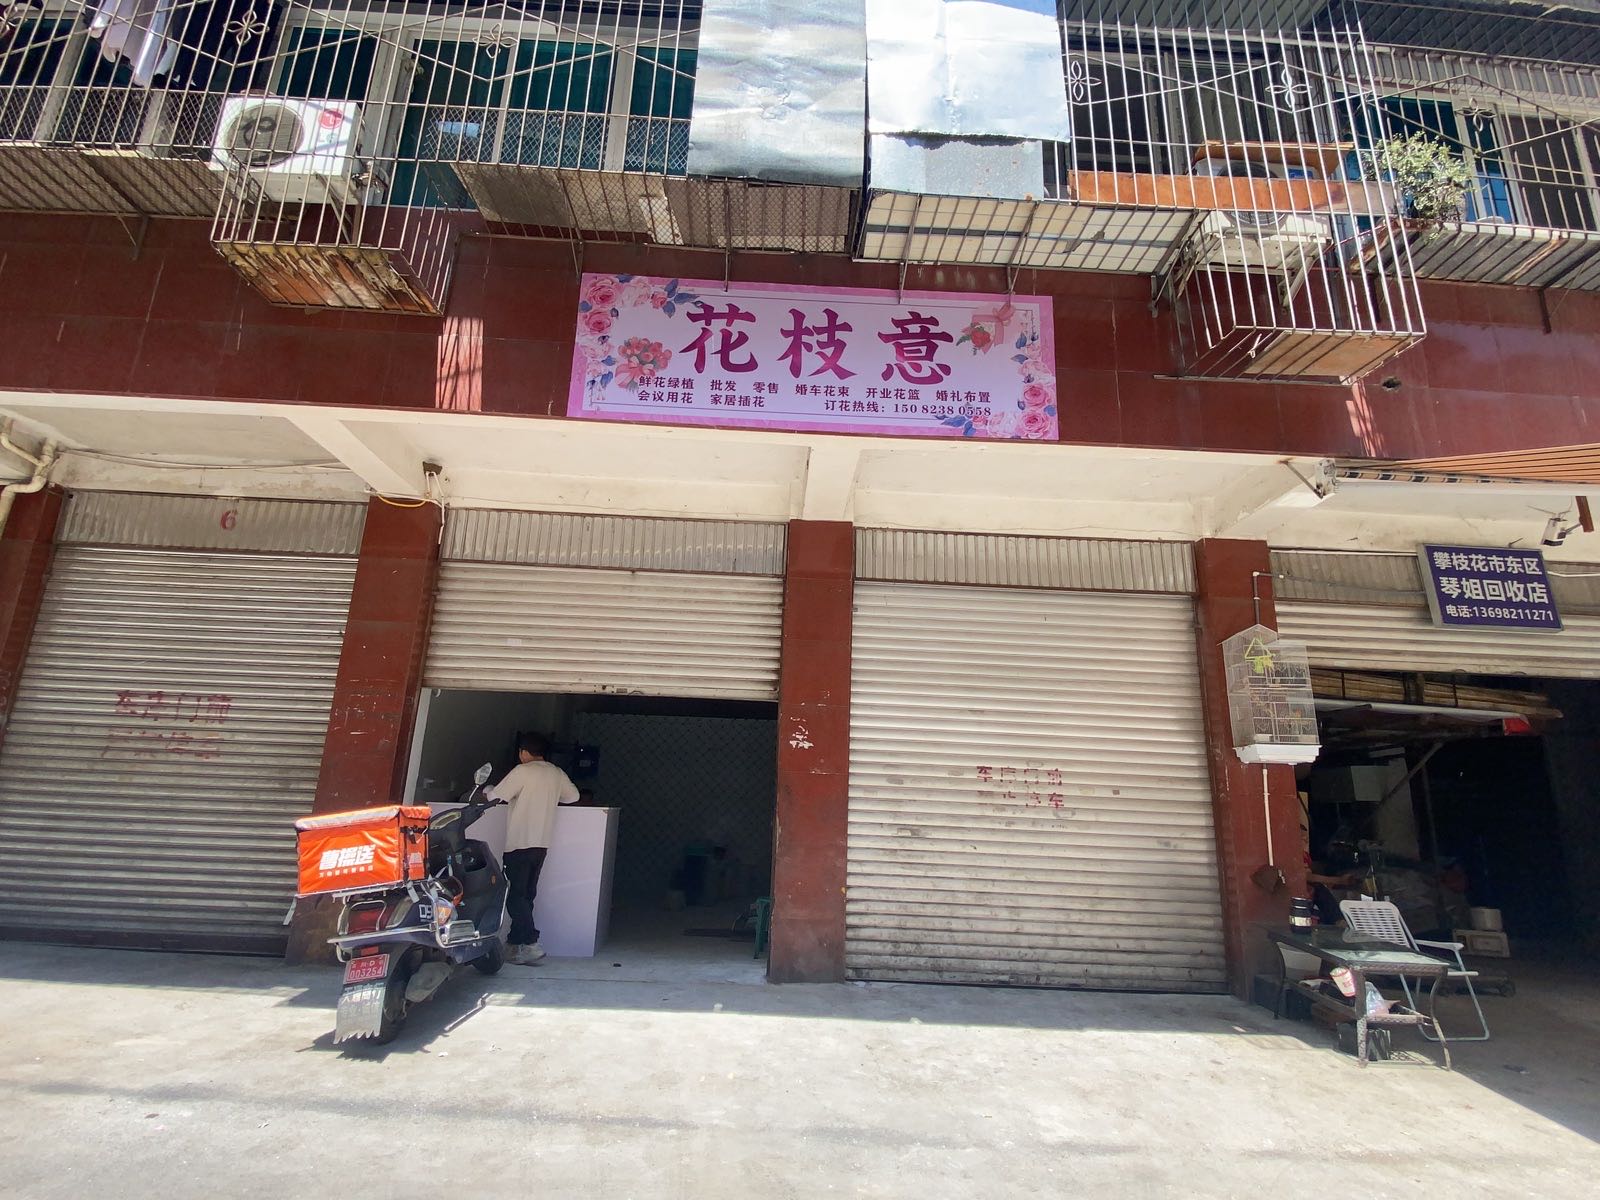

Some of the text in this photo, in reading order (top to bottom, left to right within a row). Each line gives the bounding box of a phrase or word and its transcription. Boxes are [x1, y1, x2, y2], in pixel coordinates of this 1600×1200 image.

[679, 303, 954, 385] 花枝意
[638, 375, 695, 390] 鲜花绿植
[710, 379, 737, 392] 批发
[753, 381, 779, 394] 零售
[866, 387, 921, 401] 开业花篮
[936, 390, 991, 404] 婚礼布置
[638, 389, 694, 404] 会议用花
[710, 394, 765, 408] 家居插花
[1433, 551, 1543, 575] 攀枝花市东区
[1439, 576, 1549, 604] 琴姐回收店
